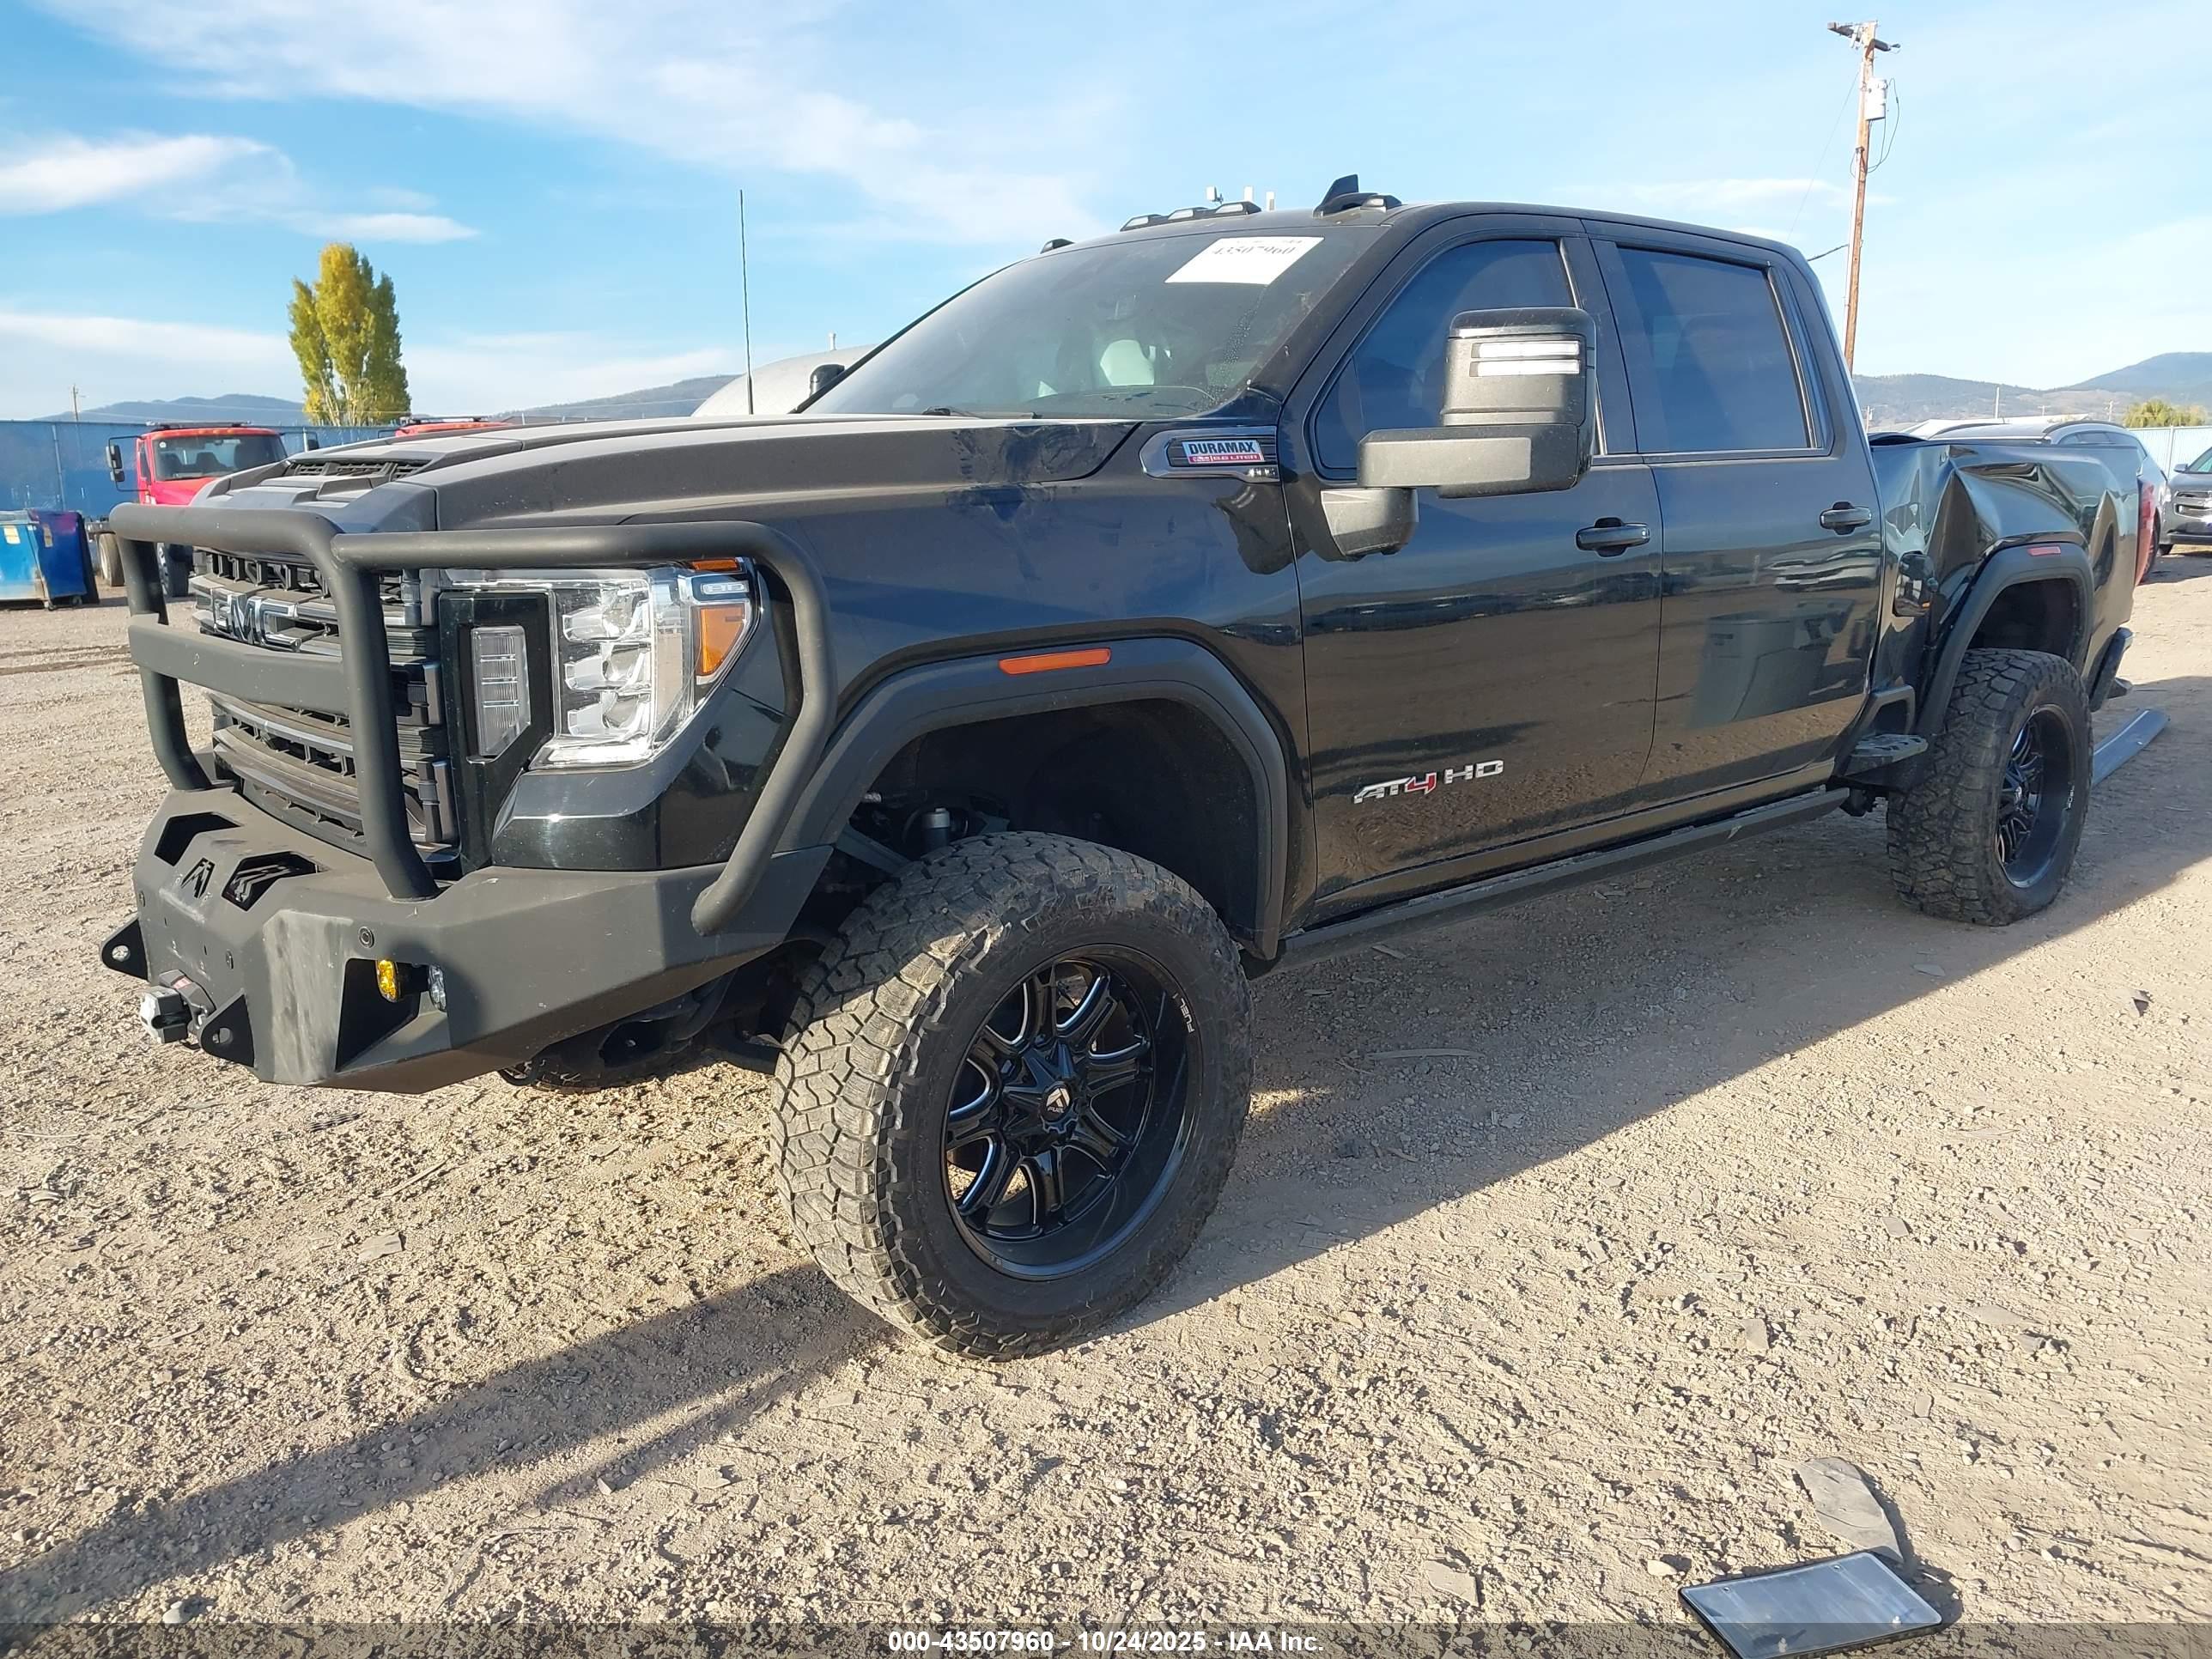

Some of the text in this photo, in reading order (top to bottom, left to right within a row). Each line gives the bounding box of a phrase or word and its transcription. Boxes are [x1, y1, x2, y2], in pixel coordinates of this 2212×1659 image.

[1188, 441, 1255, 455] DURAMAX
[210, 588, 301, 653] GMC
[1353, 759, 1504, 805] AT4 HD
[1180, 997, 1195, 1033] FUEL
